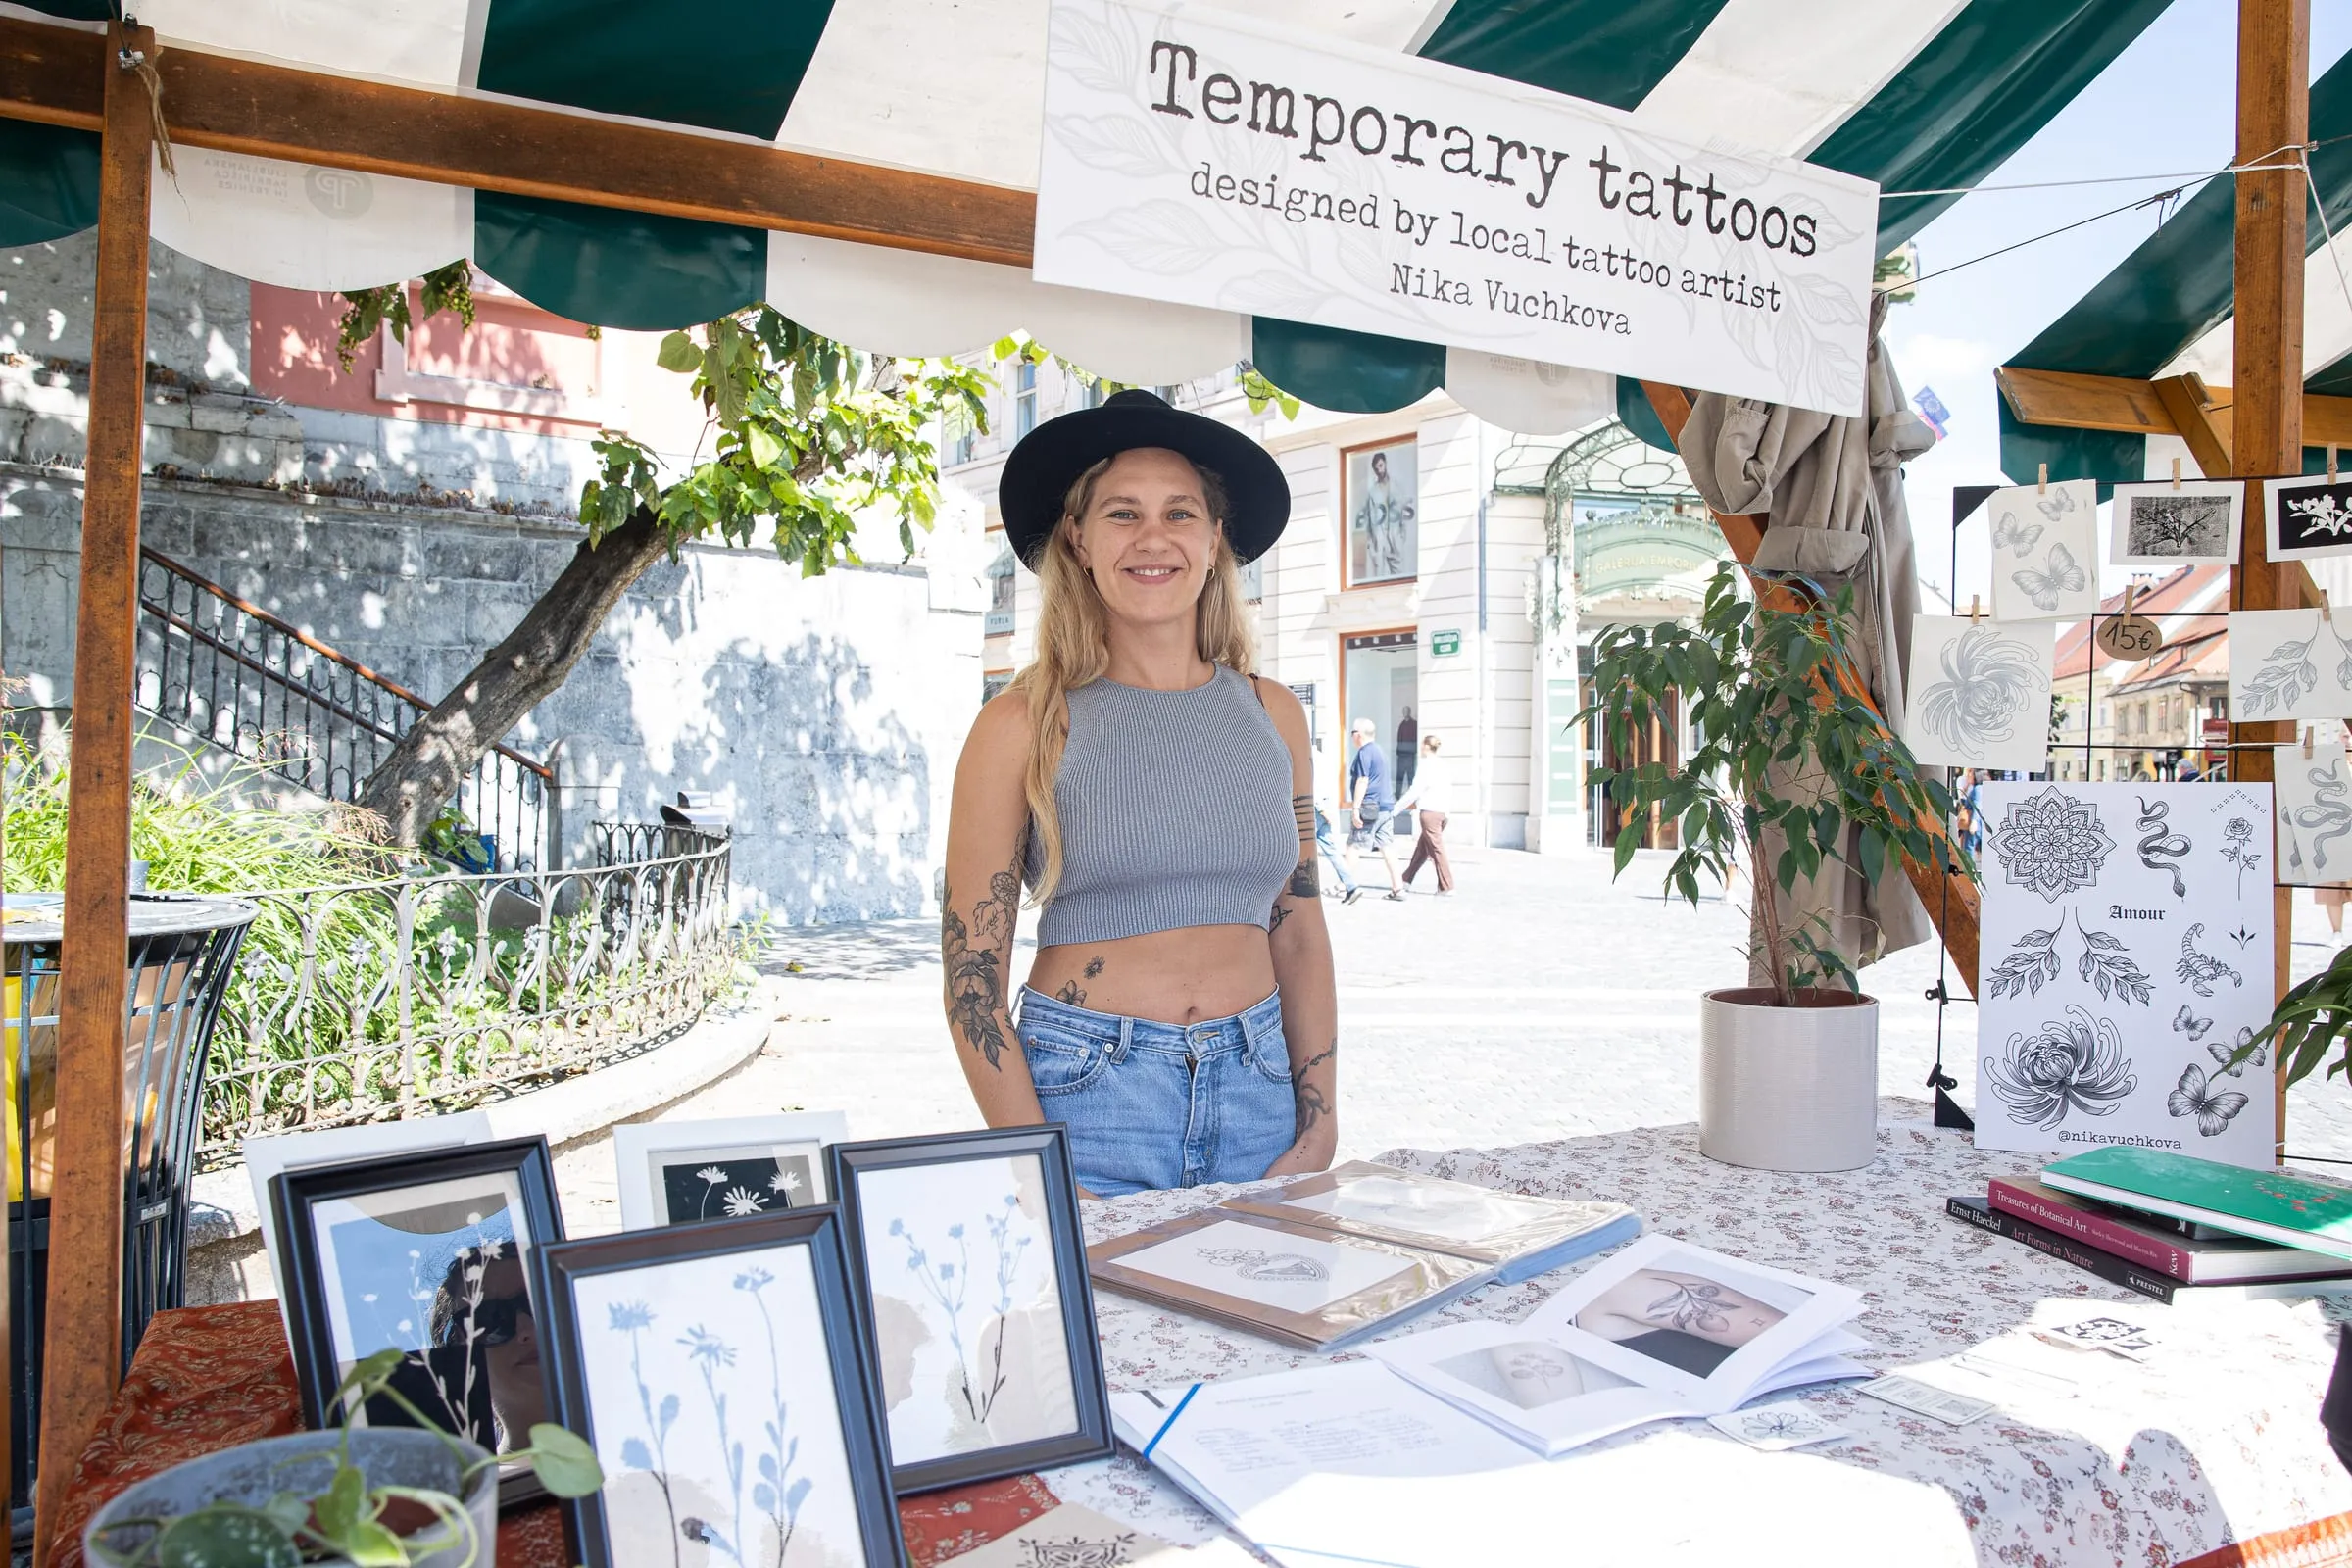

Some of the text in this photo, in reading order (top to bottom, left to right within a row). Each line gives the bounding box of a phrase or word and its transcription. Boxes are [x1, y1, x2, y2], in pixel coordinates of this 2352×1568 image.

[1151, 40, 1817, 257] Temporary tattoos
[1191, 161, 1781, 312] designed by local tattoo artist
[1390, 263, 1632, 335] Nika Vuchkova
[2105, 622, 2153, 650] 15€
[2109, 905, 2166, 920] Amour
[2058, 1130, 2182, 1150] @nikavuchkova
[1995, 1190, 2030, 1210] Treasures
[2031, 1203, 2039, 1214] of
[2039, 1205, 2073, 1228] Botanical
[2074, 1219, 2087, 1234] Art
[1950, 1201, 2094, 1269] Ernst Haeckel Art Forms in Nature
[2169, 1250, 2179, 1275] Kew
[2136, 1279, 2164, 1296] PRESTEL
